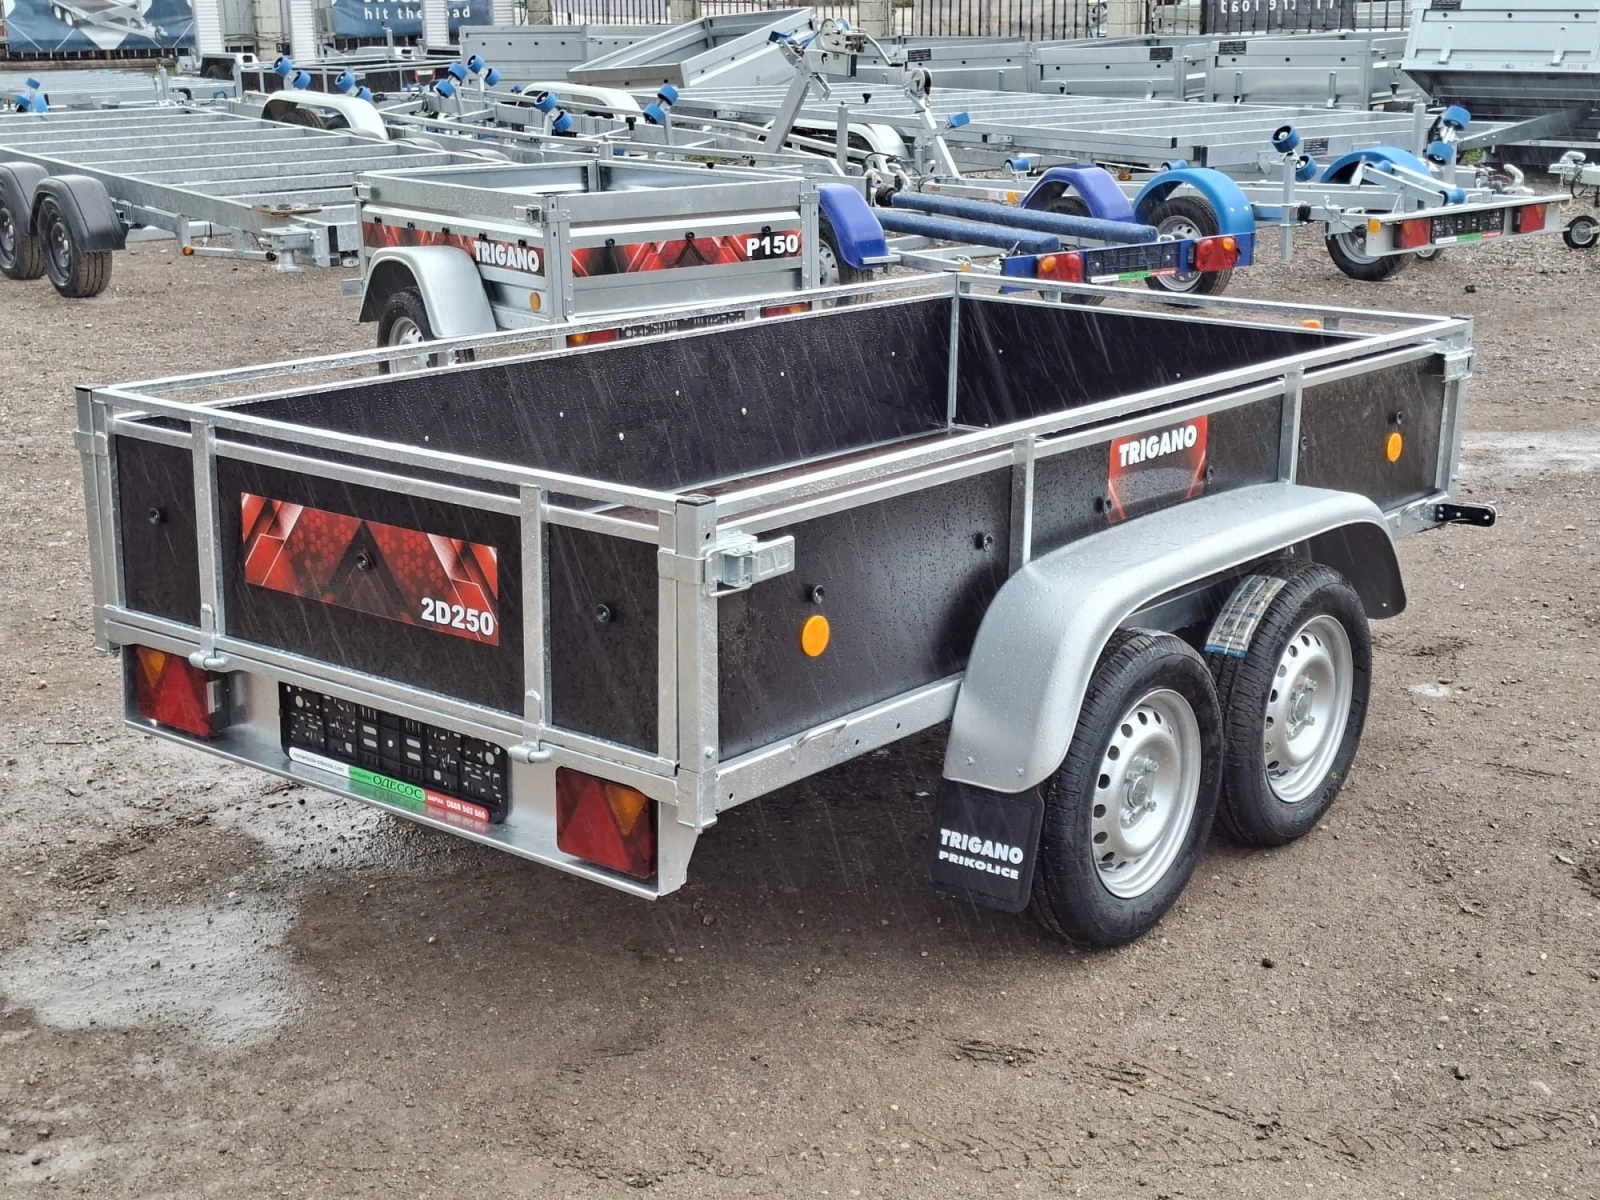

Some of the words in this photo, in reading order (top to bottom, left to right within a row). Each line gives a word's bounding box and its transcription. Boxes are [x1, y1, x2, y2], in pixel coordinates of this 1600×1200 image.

[364, 7, 389, 20] hit
[473, 240, 539, 273] TRIGANO
[746, 234, 800, 257] P150
[1118, 424, 1198, 468] TRIGANO
[421, 597, 495, 636] 2D250
[372, 775, 422, 799] ОДЕСОС
[940, 828, 1023, 865] TRIGANO
[938, 850, 1020, 880] PRIKOLICE
